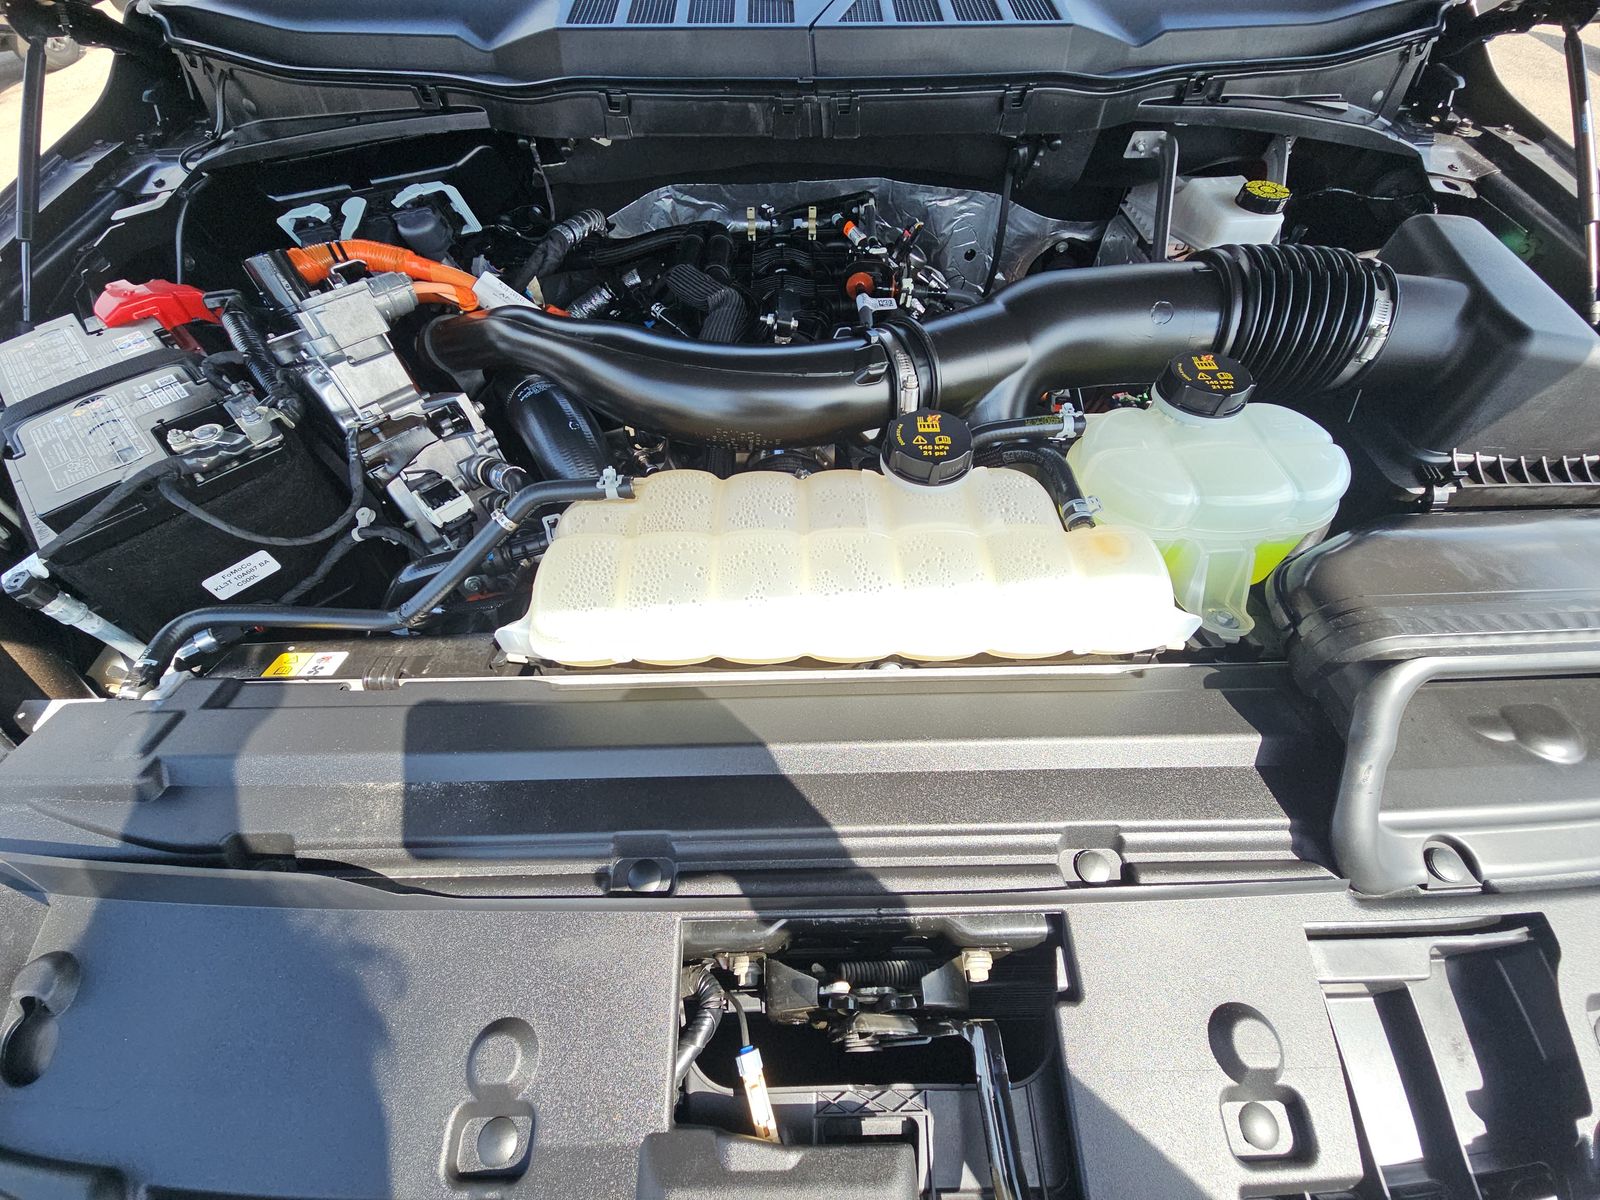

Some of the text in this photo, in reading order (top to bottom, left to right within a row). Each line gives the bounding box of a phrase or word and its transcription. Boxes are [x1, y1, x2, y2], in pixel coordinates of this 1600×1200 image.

[213, 579, 233, 592] KL3T
[258, 559, 270, 568] BA
[221, 562, 252, 579] FoMoCo
